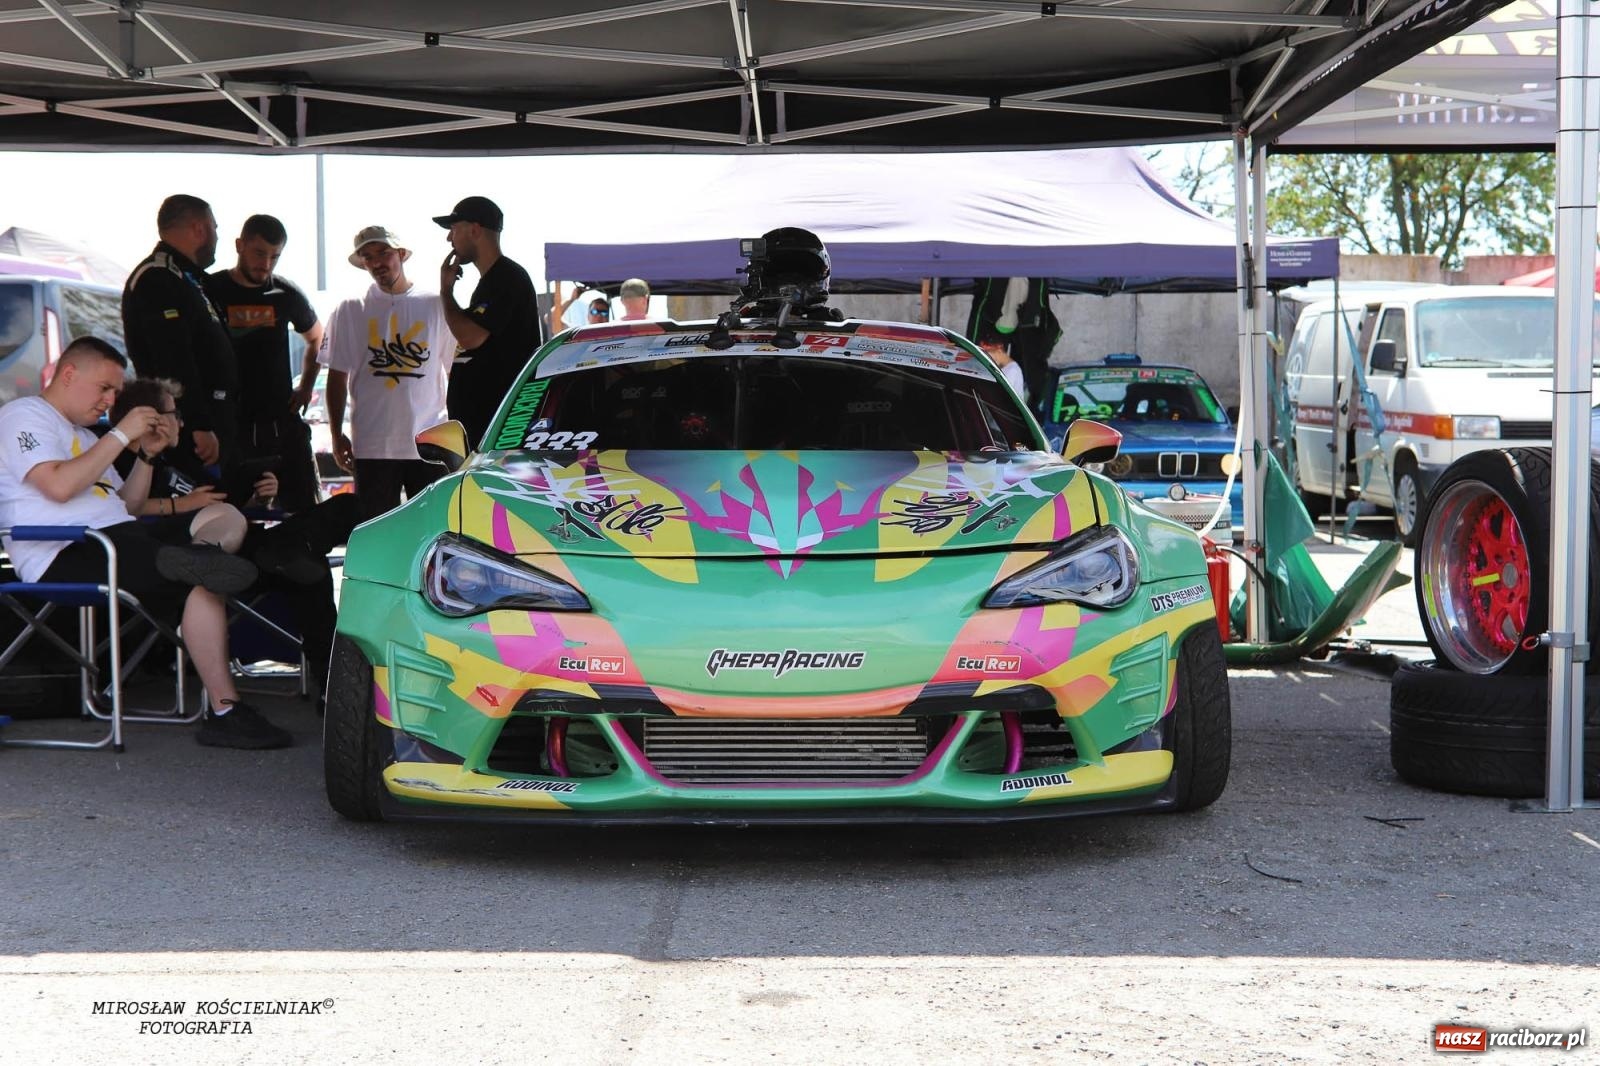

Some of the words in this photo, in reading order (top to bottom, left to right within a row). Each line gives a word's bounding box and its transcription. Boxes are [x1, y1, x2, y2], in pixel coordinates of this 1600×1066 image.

[812, 336, 841, 345] 74
[495, 379, 551, 450] TRACKWOOD
[1151, 594, 1174, 612] DTS
[1171, 585, 1206, 601] PREMIUM
[496, 780, 577, 792] ADDINOL
[1002, 773, 1072, 791] ADDINOL
